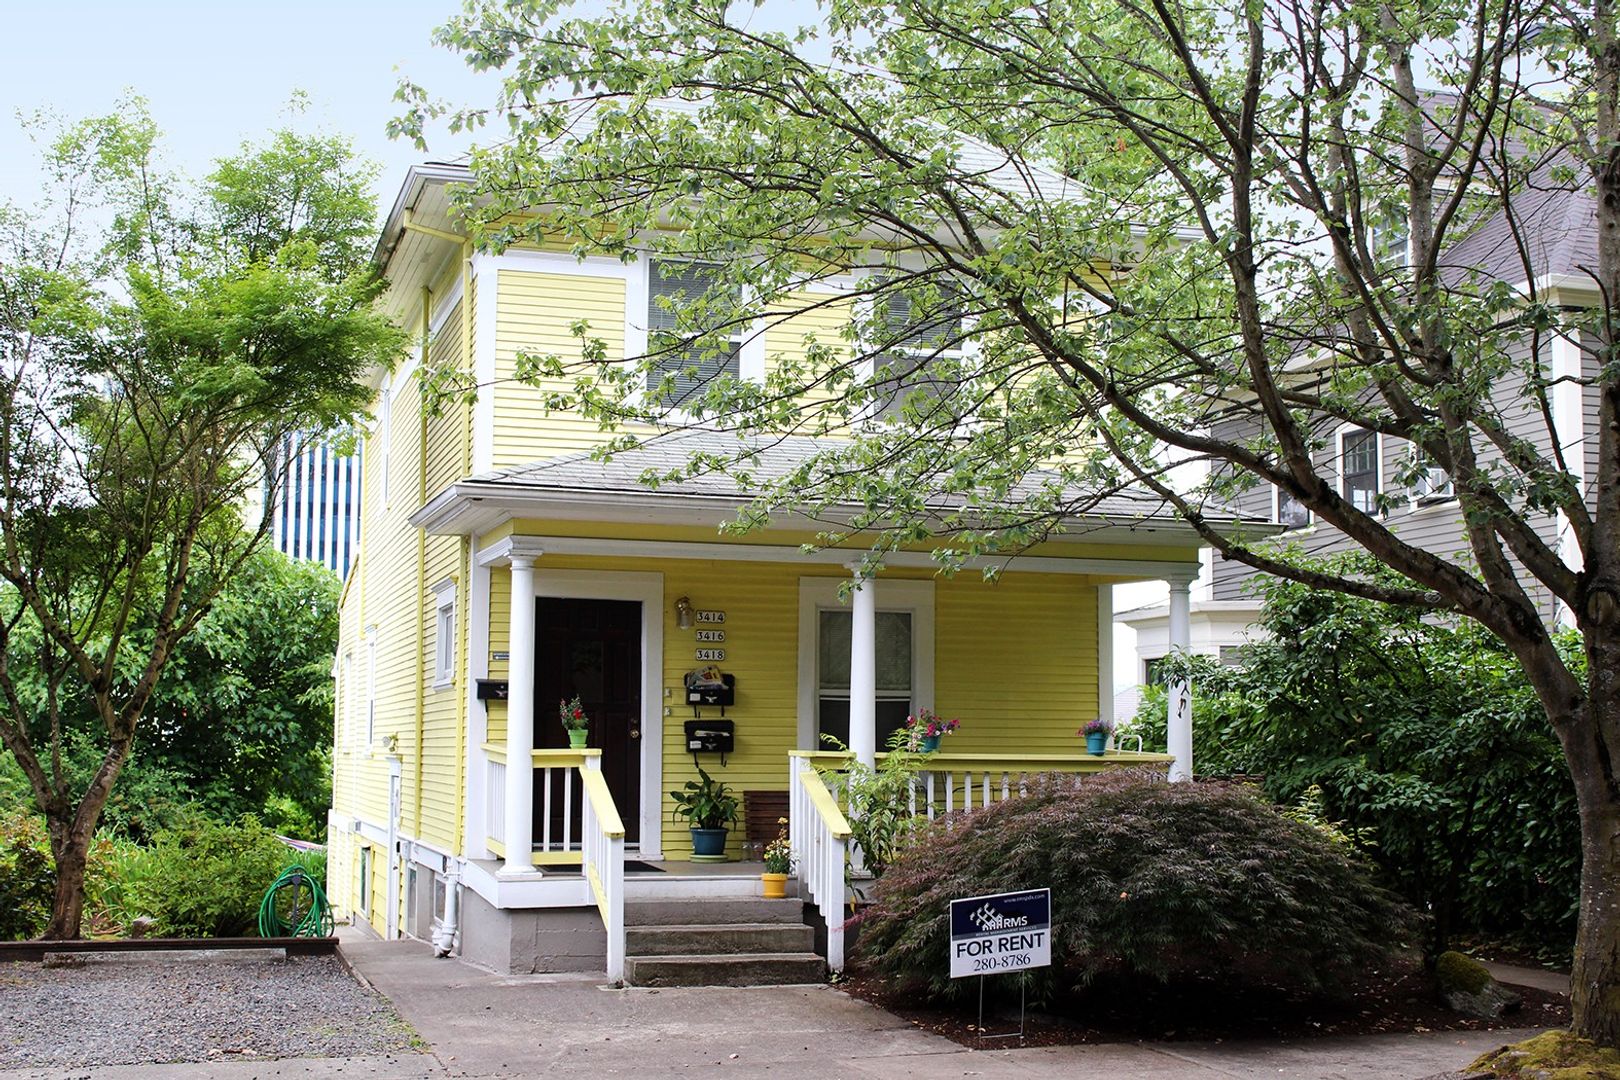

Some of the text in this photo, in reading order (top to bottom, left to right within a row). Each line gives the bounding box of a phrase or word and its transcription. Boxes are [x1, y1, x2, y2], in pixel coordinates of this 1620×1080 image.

[697, 612, 724, 622] 3414
[697, 631, 724, 641] 3416
[697, 650, 723, 660] 3418
[1003, 916, 1028, 928] RMS
[956, 932, 1045, 958] FOR RENT
[974, 953, 1031, 972] 280-8786
